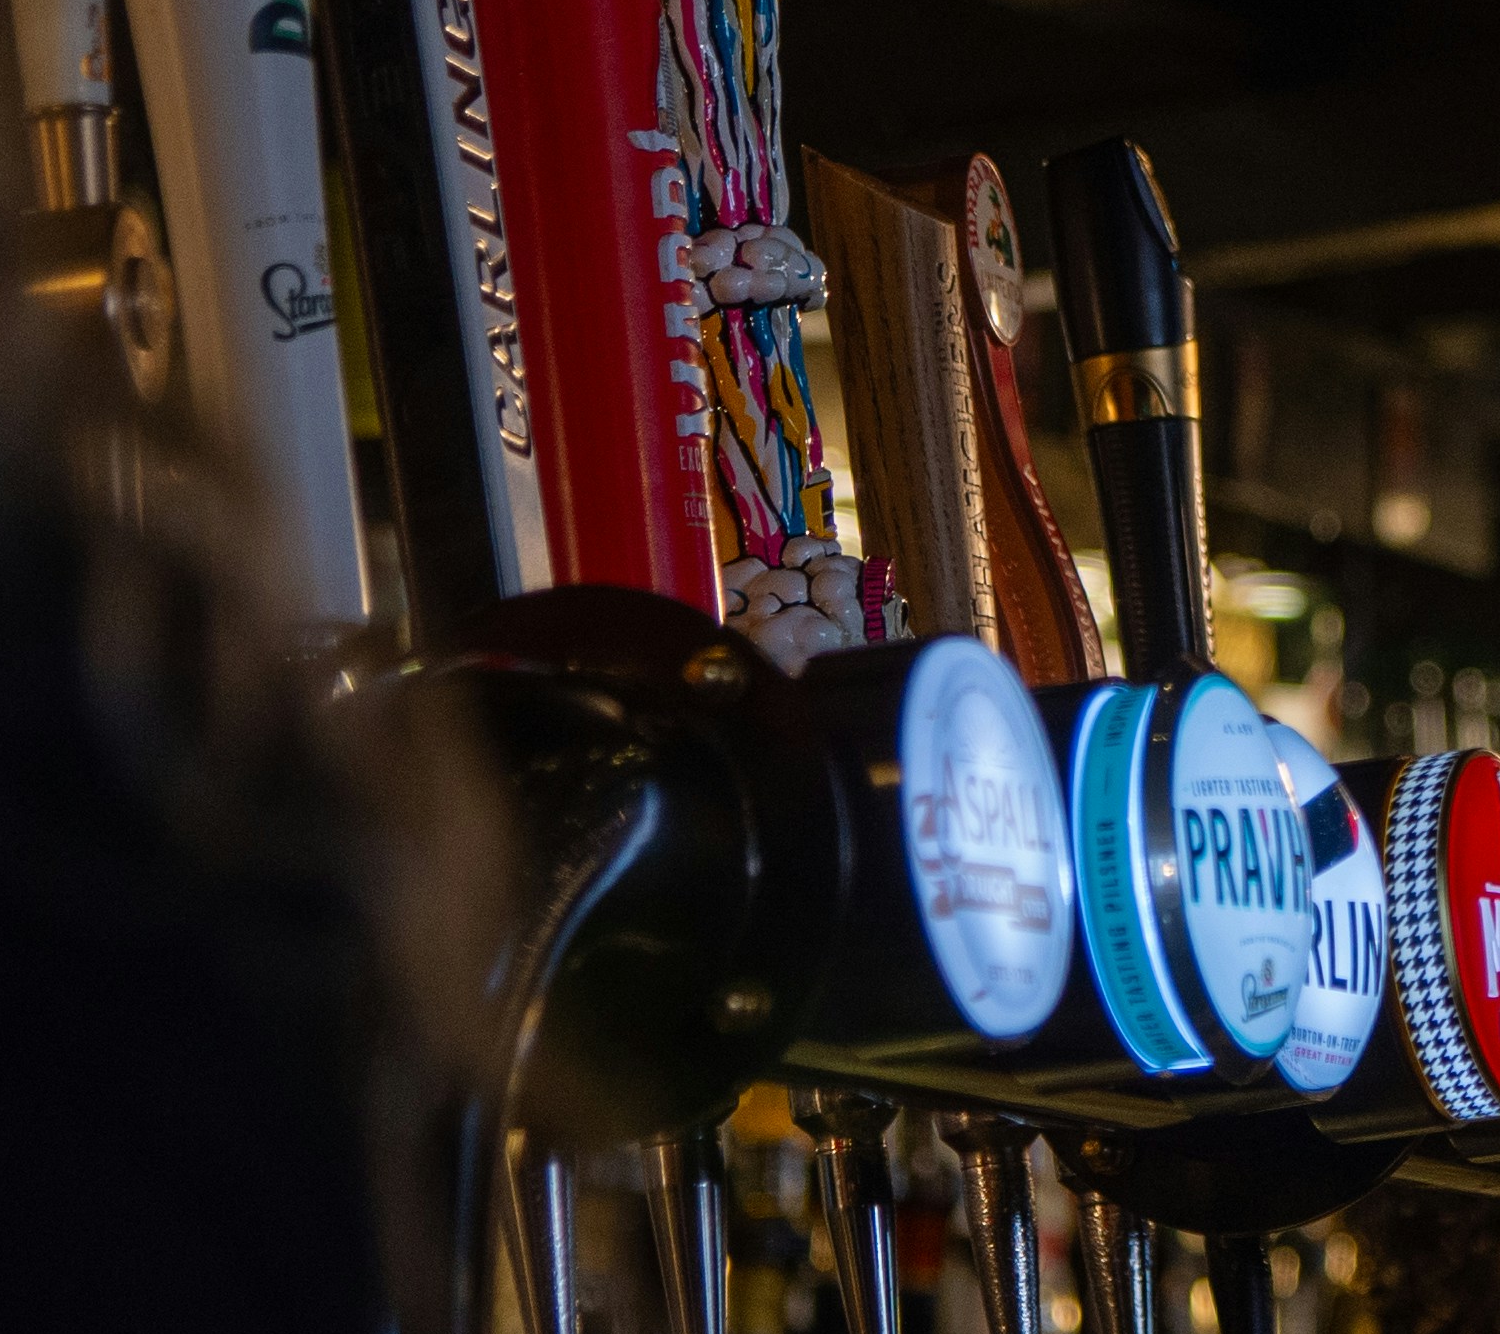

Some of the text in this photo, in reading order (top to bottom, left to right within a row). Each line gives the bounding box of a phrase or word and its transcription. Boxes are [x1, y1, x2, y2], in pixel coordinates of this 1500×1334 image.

[940, 750, 1053, 862] ASPALL
[1191, 778, 1231, 798] LIGHTER
[1234, 778, 1273, 798] TASTING
[1096, 818, 1124, 914] PILSNER
[1181, 808, 1311, 913] PRAVH
[1306, 898, 1383, 998] RLIN
[1294, 1046, 1323, 1062] GREAT
